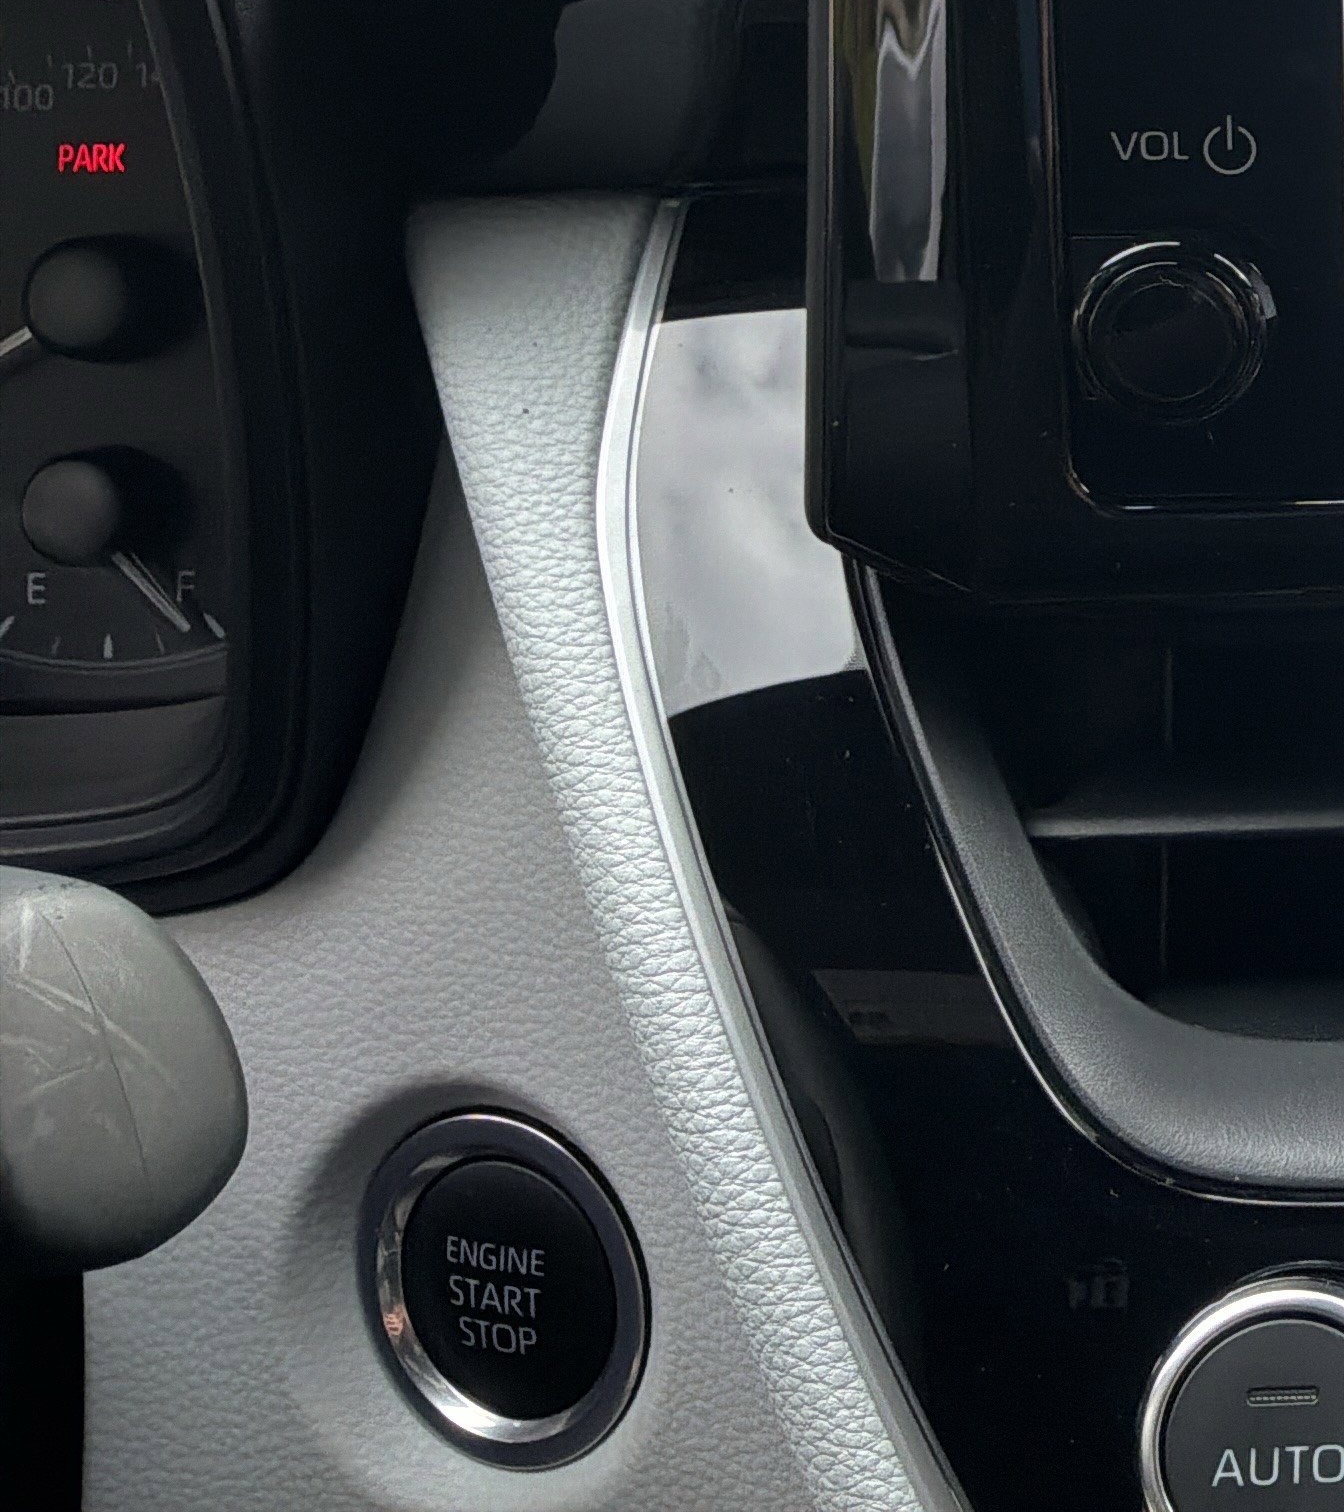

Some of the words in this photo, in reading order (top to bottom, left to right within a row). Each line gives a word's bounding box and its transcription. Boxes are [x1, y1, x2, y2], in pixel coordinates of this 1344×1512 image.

[62, 62, 119, 90] 120
[58, 143, 126, 174] PARK
[1110, 130, 1190, 161] VOL
[27, 572, 46, 605] E
[176, 570, 196, 603] F
[446, 1236, 546, 1278] ENGINE
[449, 1275, 542, 1318] START
[458, 1317, 538, 1355] STOP
